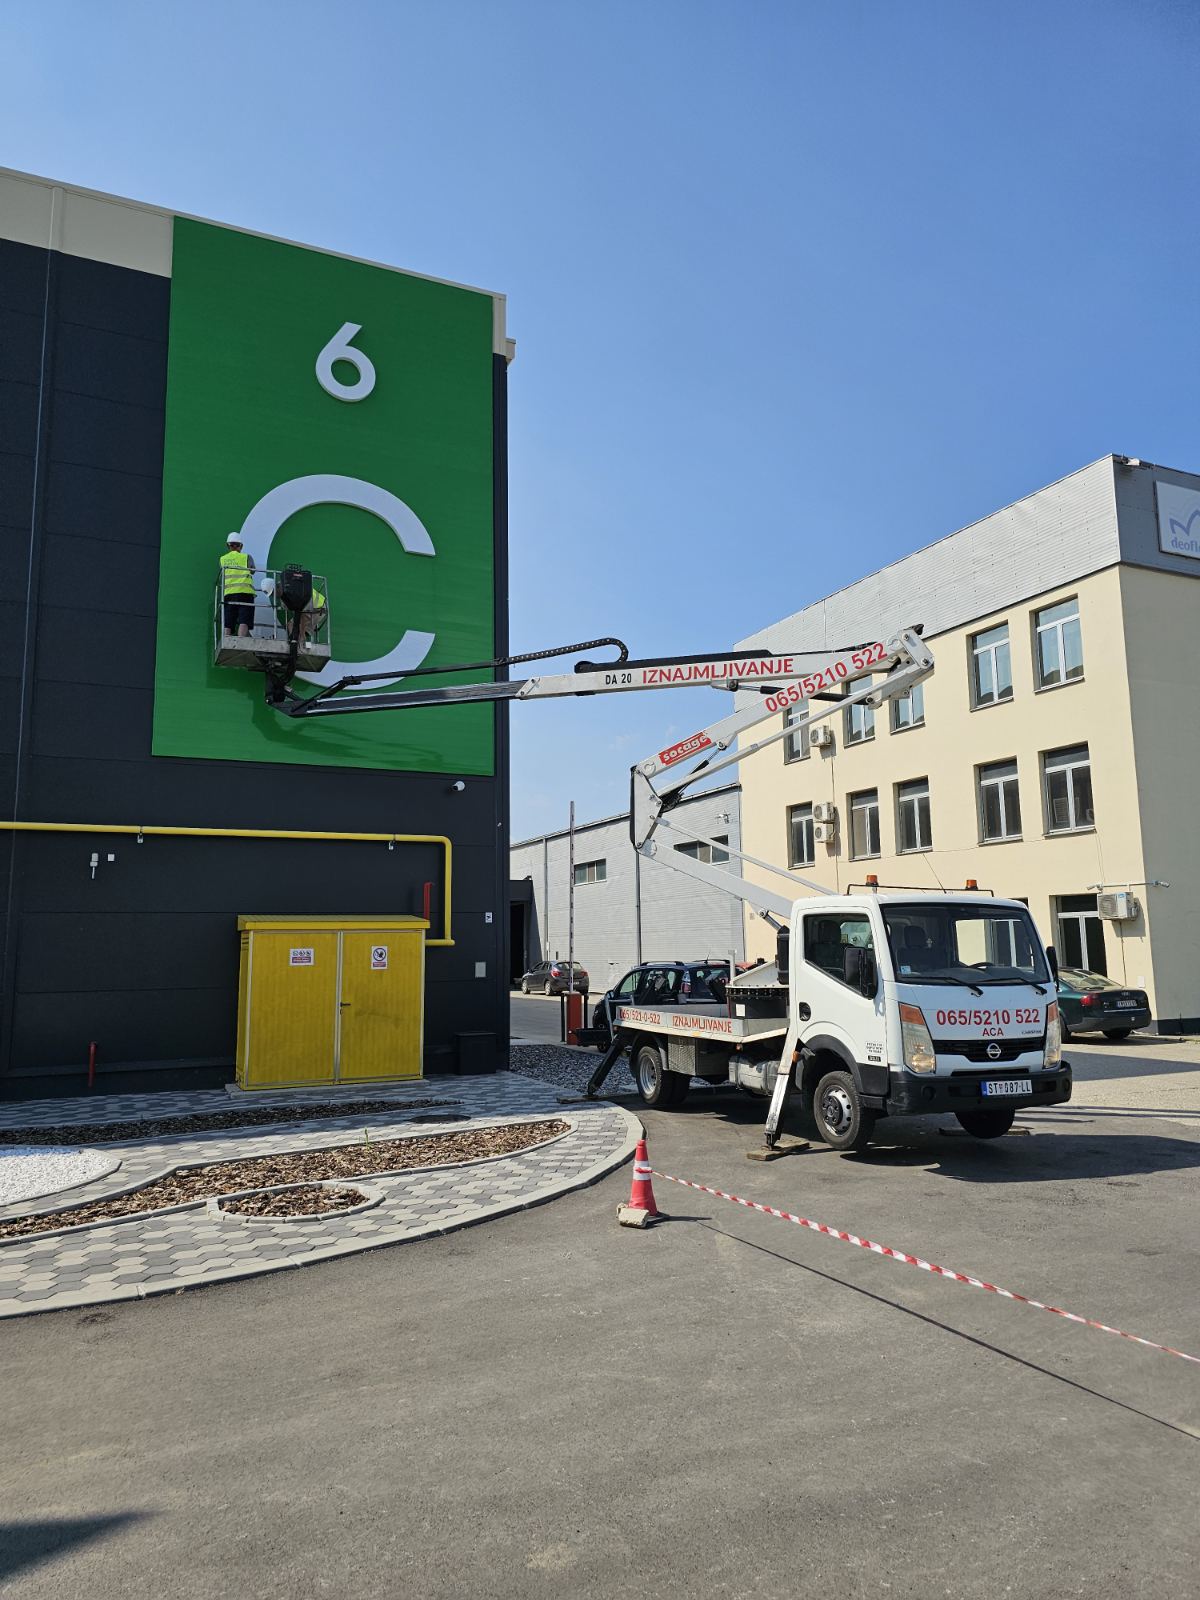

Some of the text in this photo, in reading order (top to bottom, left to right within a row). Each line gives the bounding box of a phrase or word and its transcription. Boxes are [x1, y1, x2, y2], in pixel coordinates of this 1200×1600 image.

[315, 321, 376, 403] 6
[239, 474, 436, 690] C
[605, 672, 632, 685] DA 20
[642, 658, 794, 684] IZNAJMLJIVANJE
[765, 642, 888, 713] 065/5210 522
[663, 735, 709, 761] socage
[672, 1015, 732, 1034] IZNAJMLJIVANJE
[936, 1008, 1041, 1026] 065/5210 522
[982, 1027, 1005, 1037] ACA
